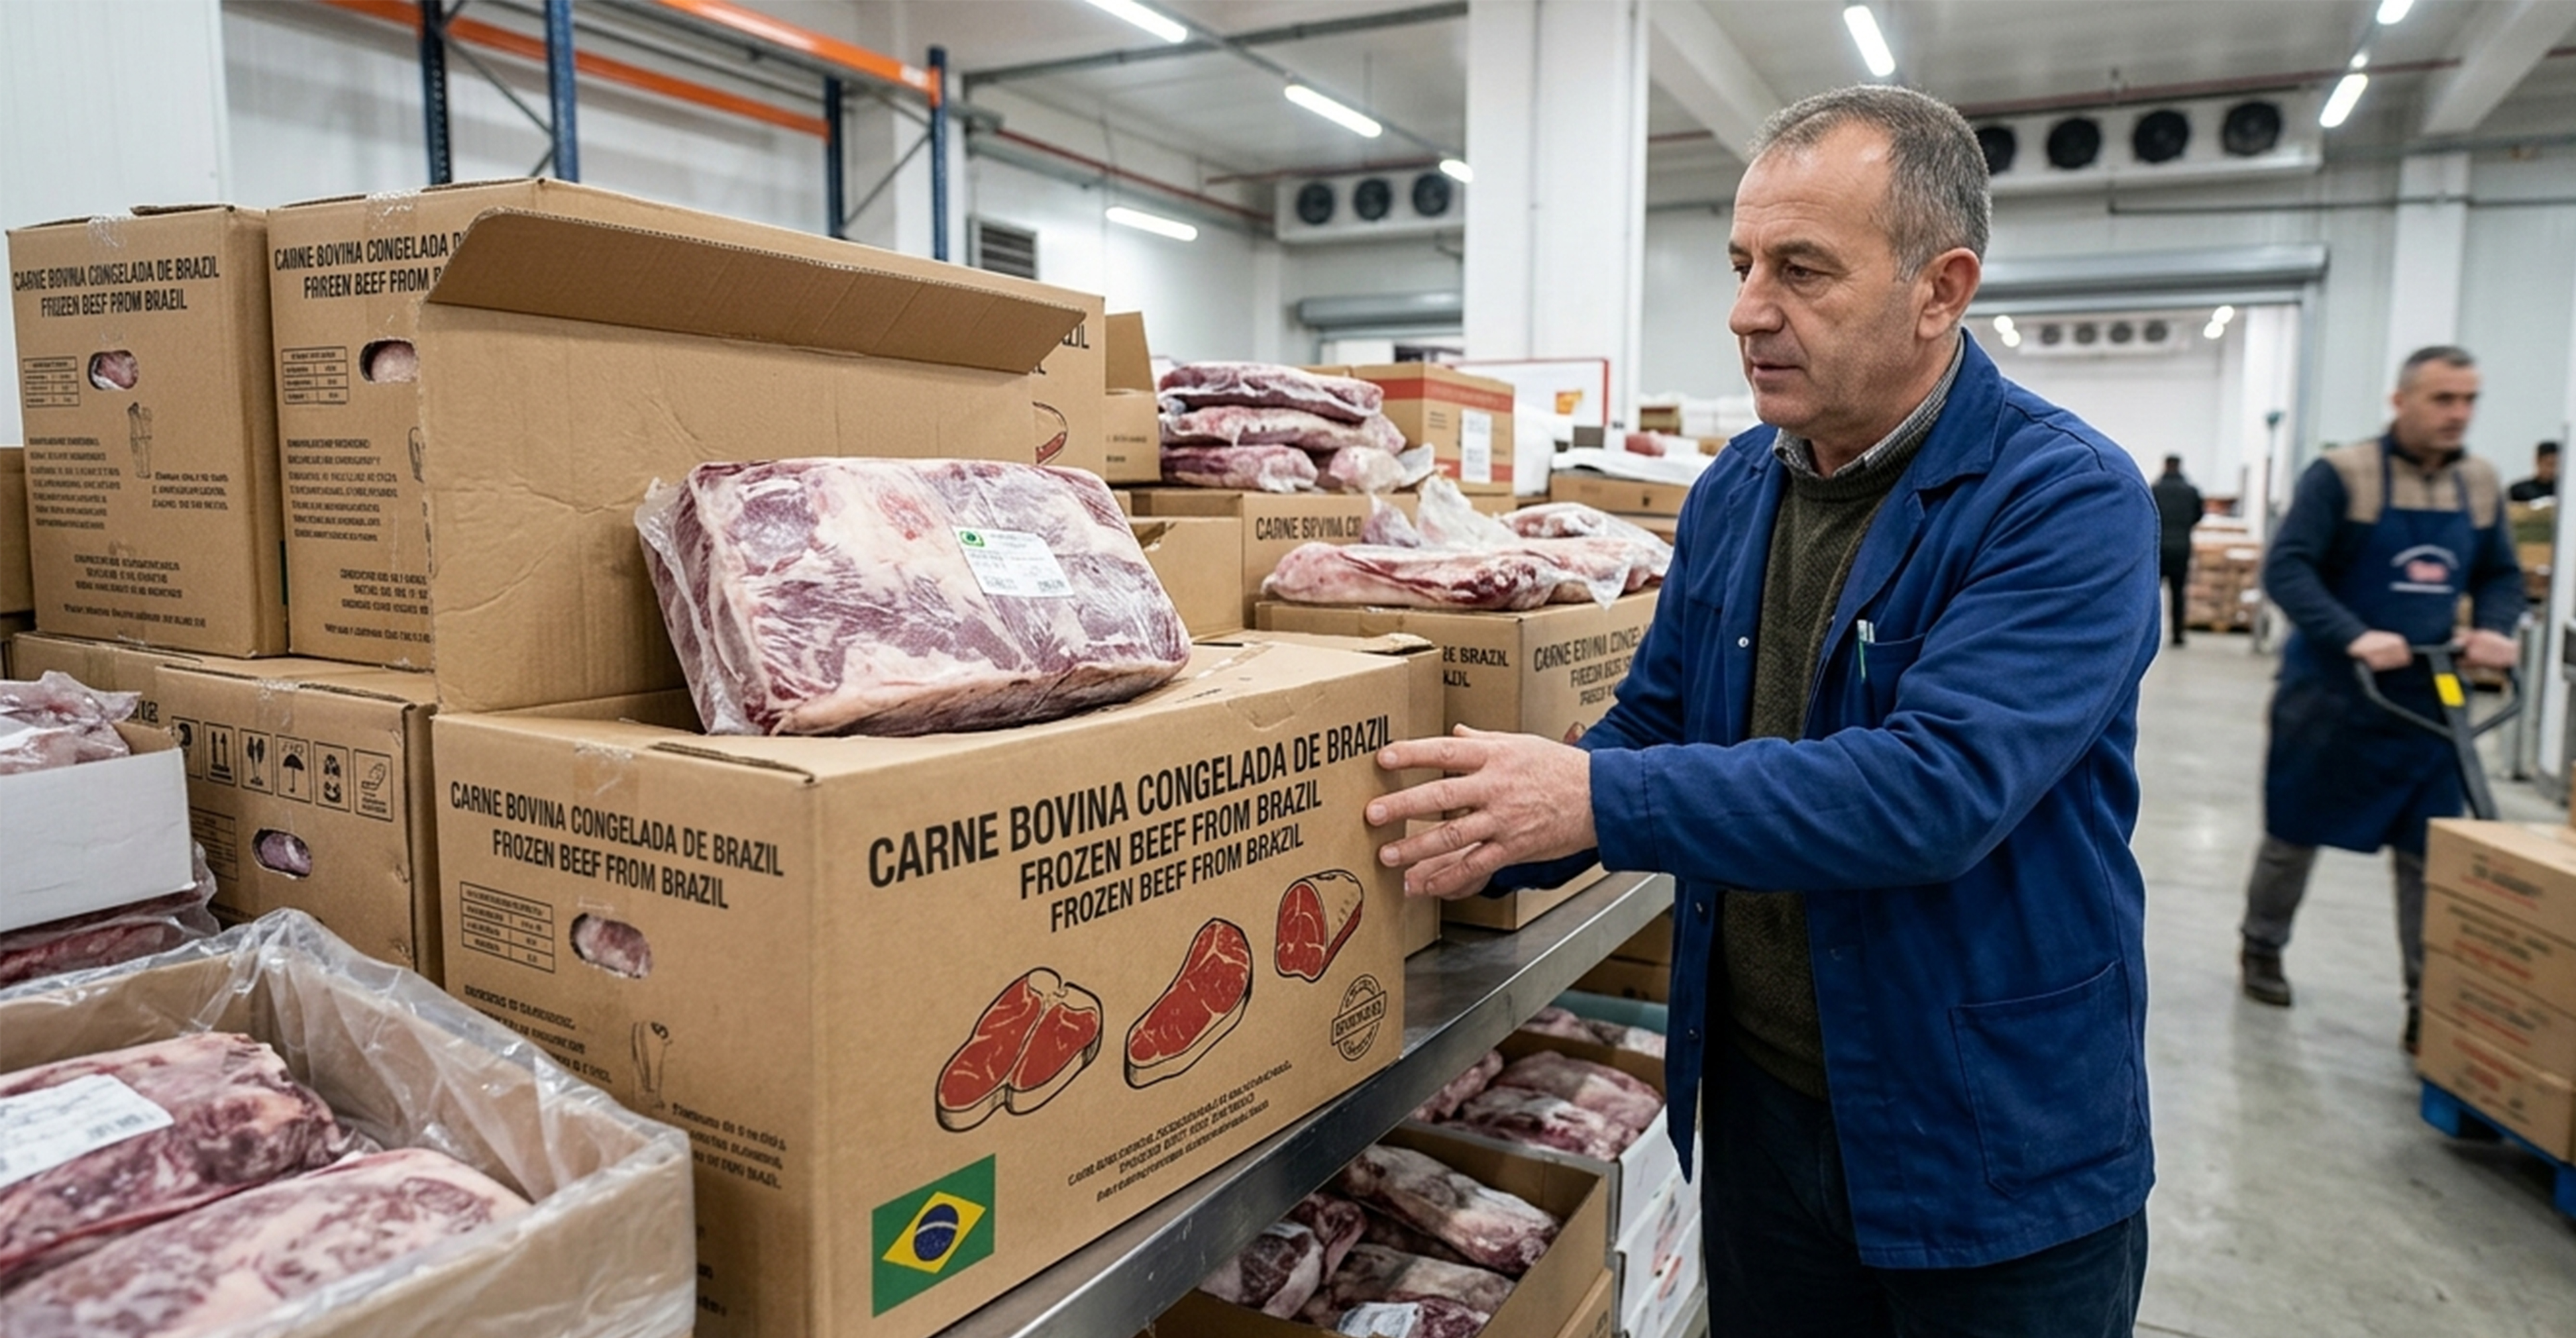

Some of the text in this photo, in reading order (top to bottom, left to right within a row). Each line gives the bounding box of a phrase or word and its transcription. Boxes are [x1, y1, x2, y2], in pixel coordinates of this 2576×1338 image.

[156, 258, 174, 282] DE
[355, 270, 386, 296] BEEF
[450, 780, 784, 877] CARNE BOVINA CONGELADA DE BRAZIL
[869, 715, 1393, 888] CARNE BOVINA CONGELADA DE BRAZIL
[1020, 779, 1322, 900] FROZEN BEEF FROM BRAZIL
[493, 829, 729, 910] FROZEN BEEF FROM BRAZIL
[1051, 823, 1304, 933] FROZEN BEEF FROM BRAZIL
